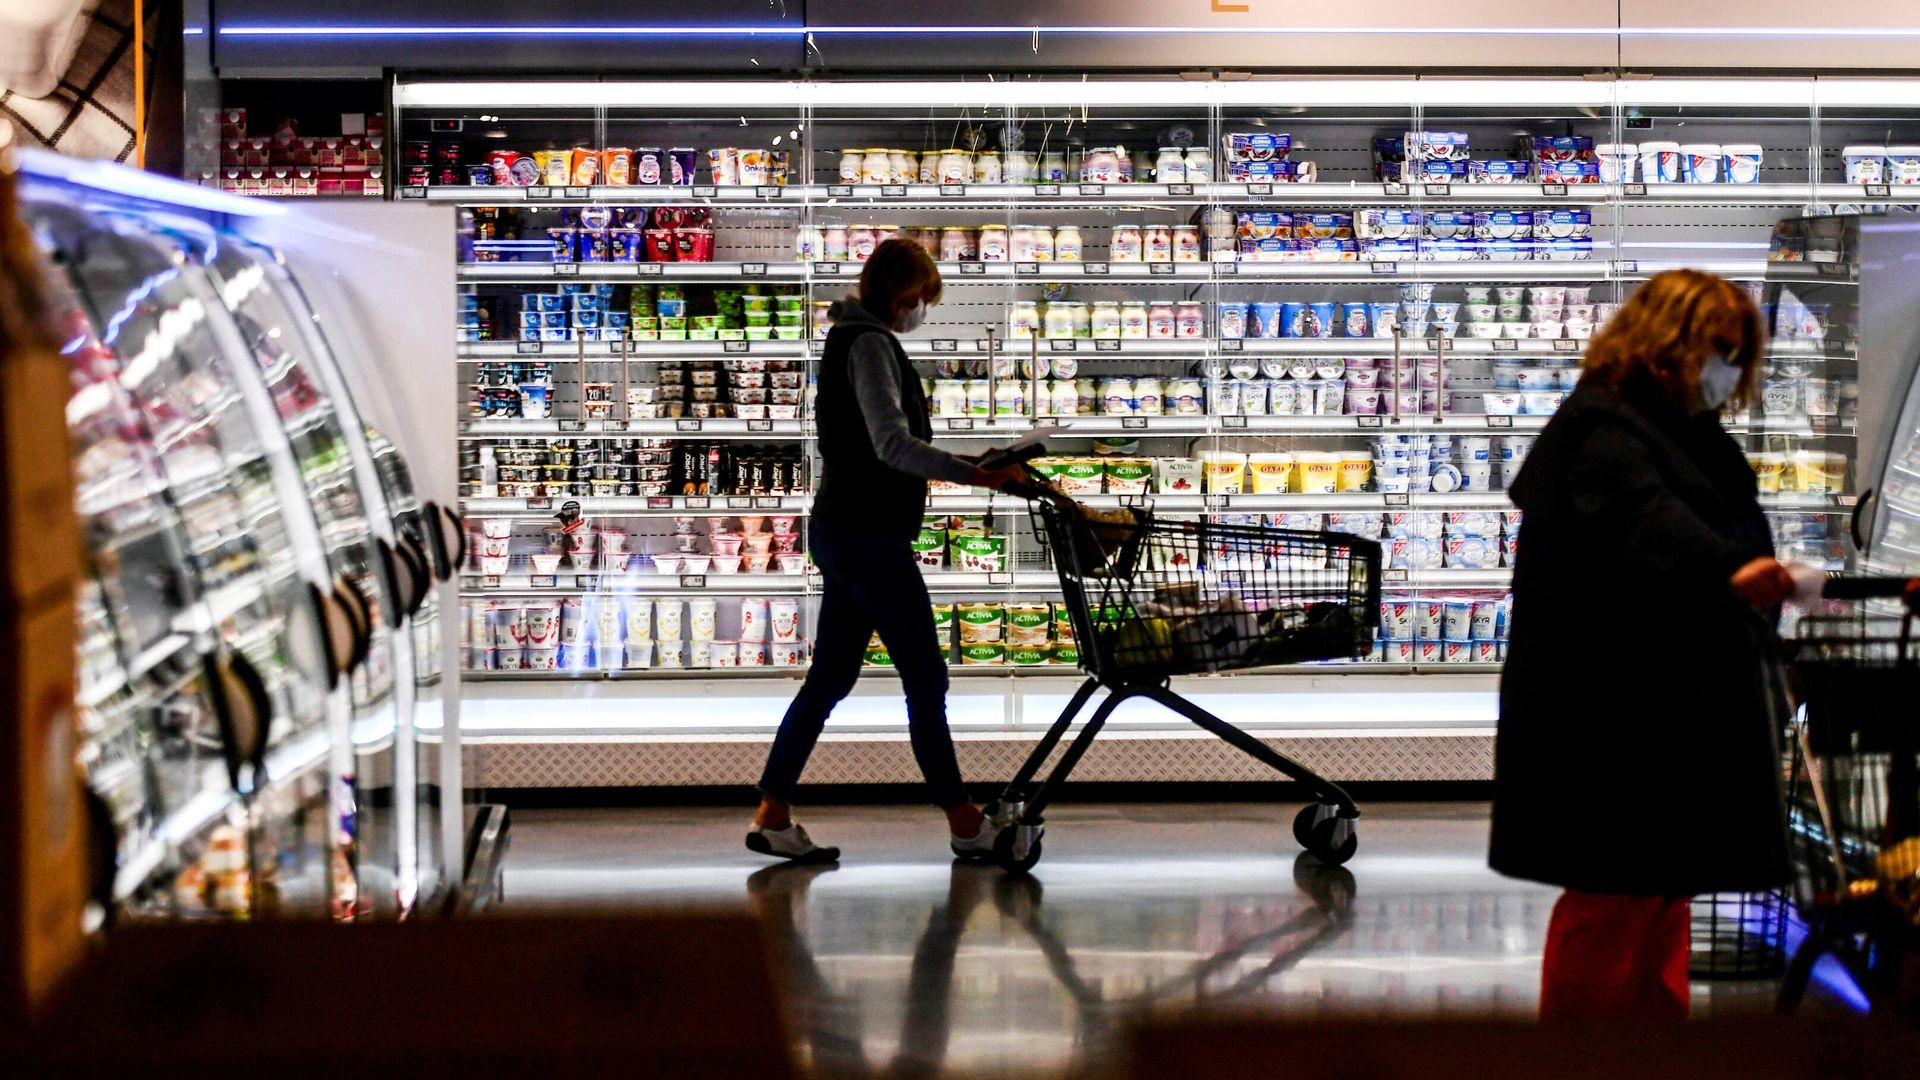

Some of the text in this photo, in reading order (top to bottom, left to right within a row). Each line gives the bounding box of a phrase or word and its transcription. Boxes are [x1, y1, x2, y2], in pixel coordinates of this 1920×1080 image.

[1068, 466, 1094, 474] ACTIVIA
[1116, 467, 1142, 475] ACTIVIA
[966, 542, 992, 550] ACTIVIA
[967, 611, 993, 619] ACTIVIA
[1014, 614, 1040, 622] ACTIVIA
[1473, 616, 1490, 624] SKYR
[970, 647, 995, 656] ACTIVIA
[1015, 651, 1041, 659] ACTIVIA
